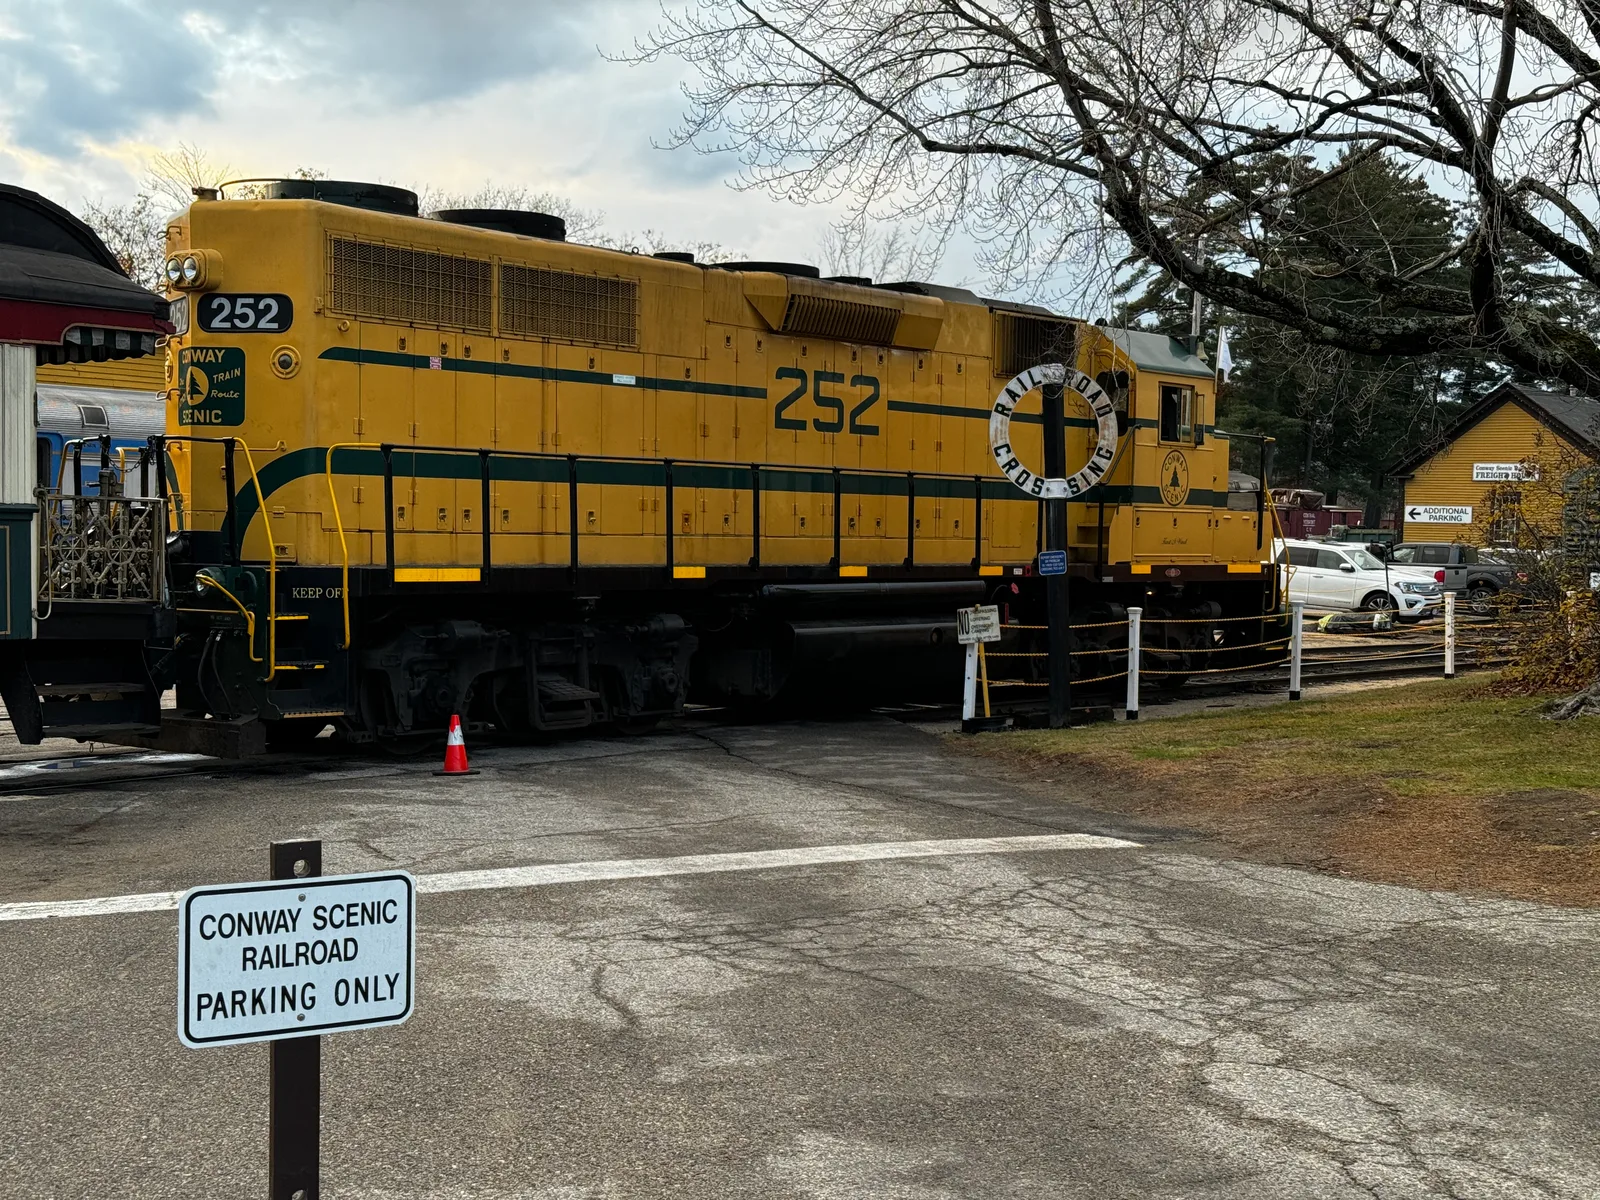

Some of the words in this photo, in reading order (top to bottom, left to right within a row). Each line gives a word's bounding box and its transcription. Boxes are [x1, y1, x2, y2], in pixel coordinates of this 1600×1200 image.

[210, 297, 279, 329] 252
[212, 367, 241, 384] TRAIN
[211, 389, 240, 399] Route
[775, 366, 880, 436] 252
[1164, 453, 1187, 473] CONWAY
[1164, 484, 1185, 503] SCENIC
[1423, 507, 1469, 515] ADDITIONAL
[292, 587, 323, 599] KEEP
[957, 610, 970, 635] NO
[199, 907, 302, 941] CONWAY
[312, 898, 398, 931] SCENIC
[241, 937, 359, 972] RAILROAD
[196, 982, 316, 1022] PARKING
[334, 972, 400, 1007] ONLY
